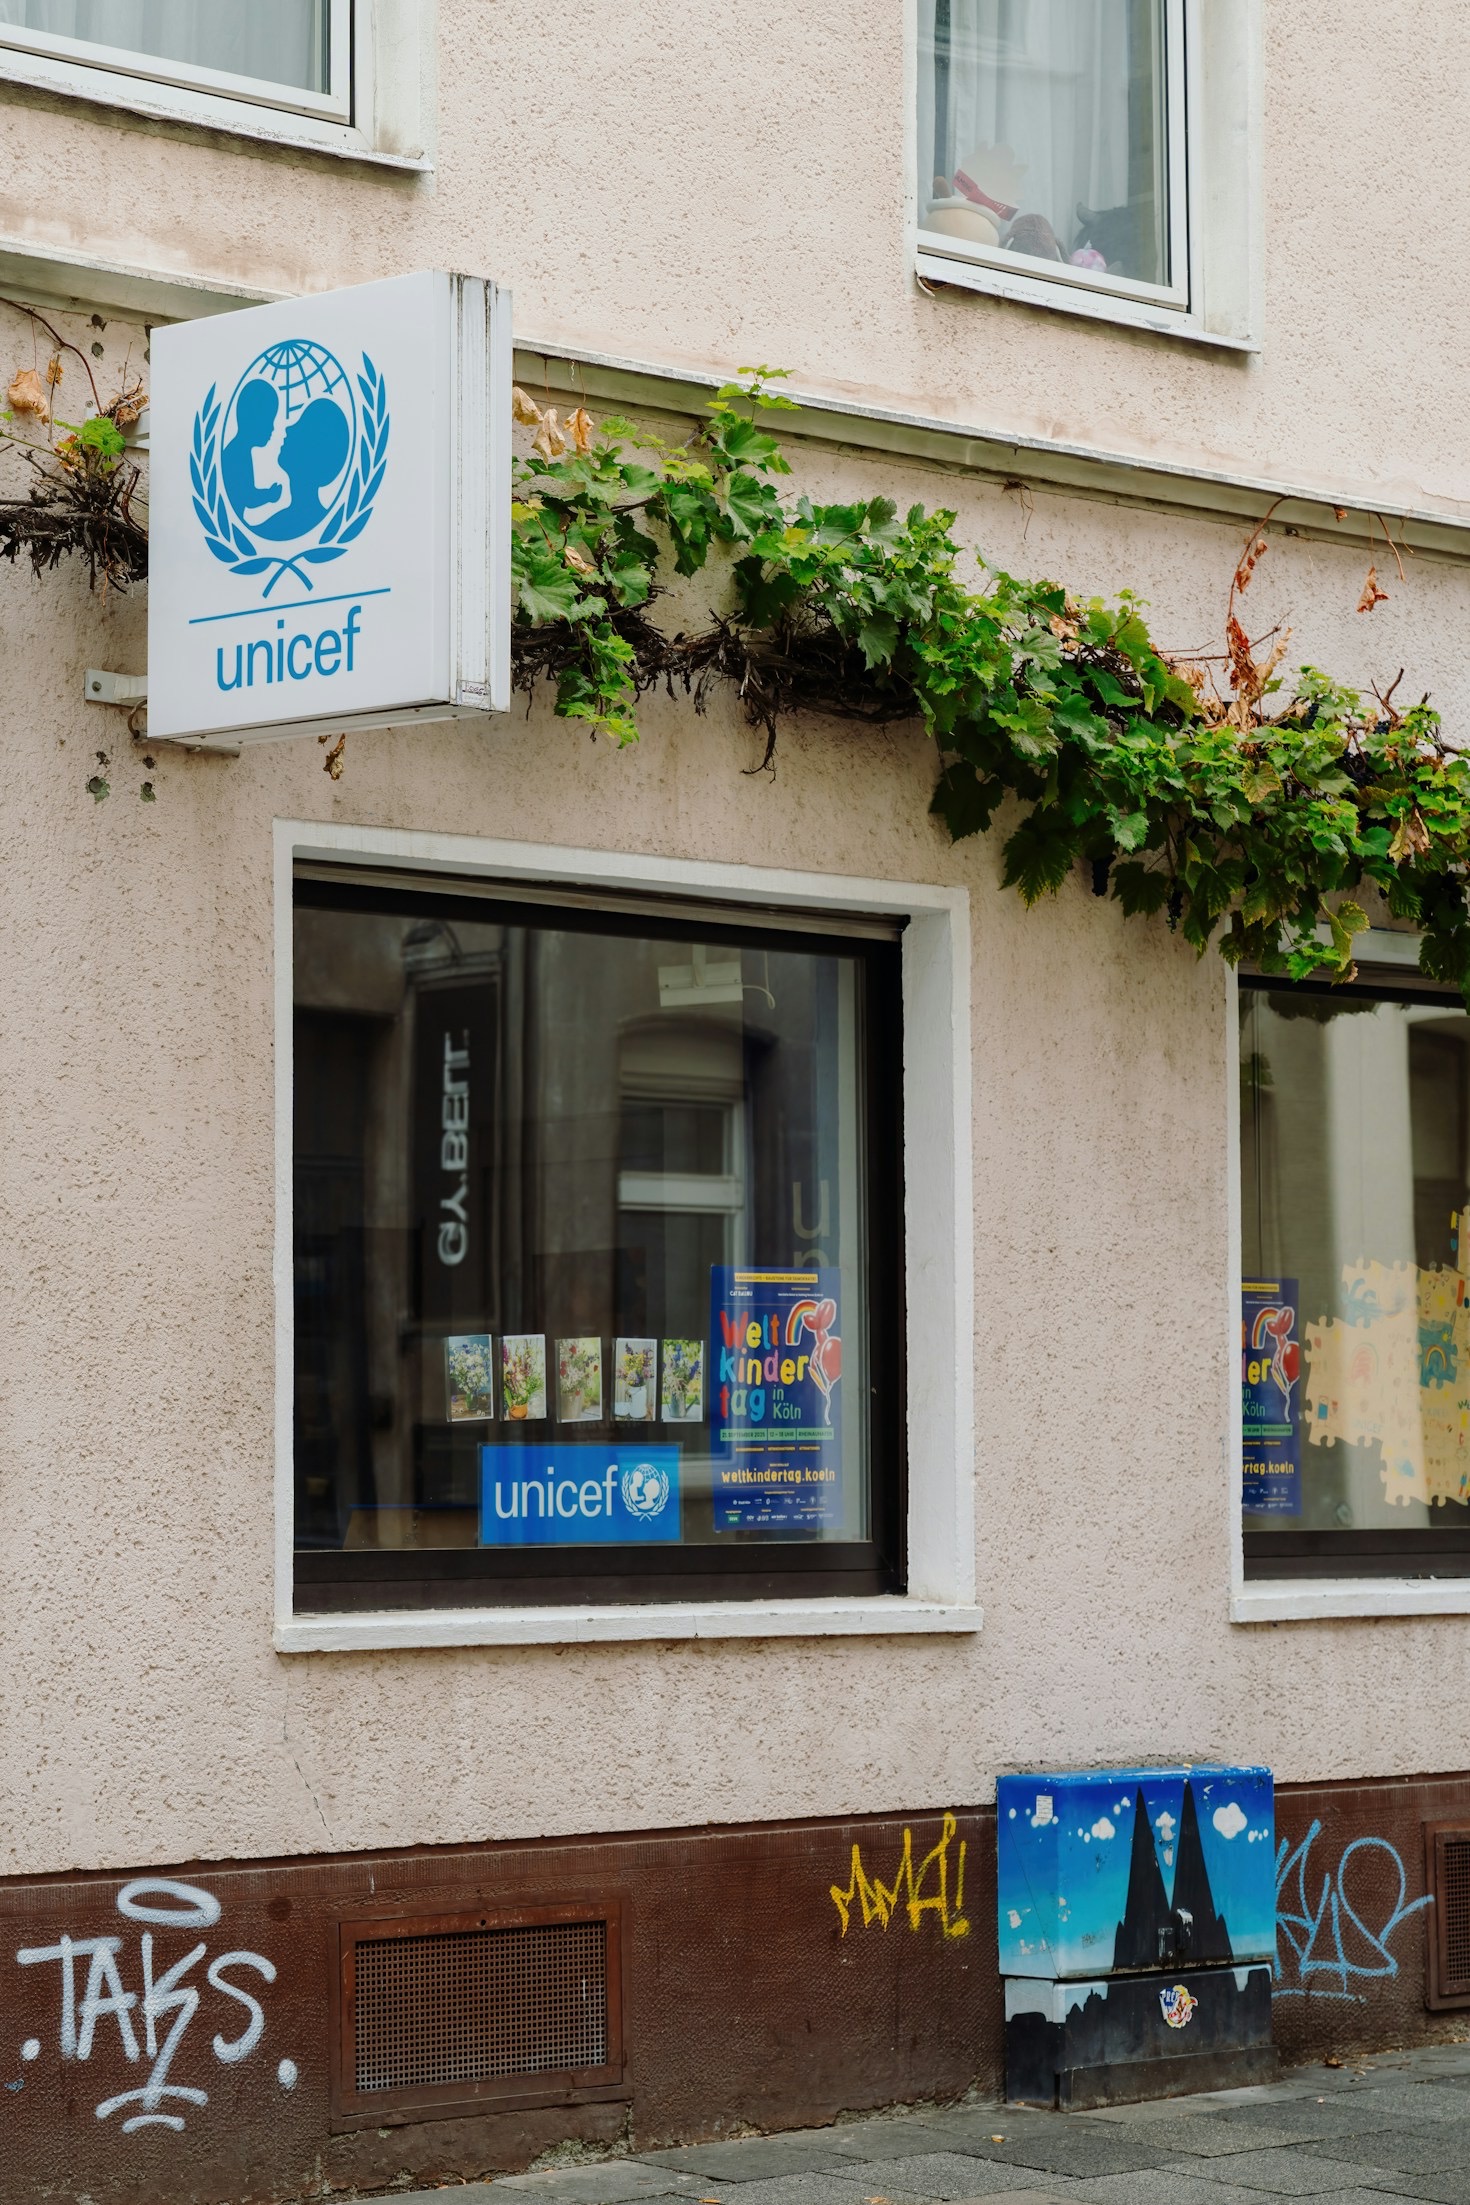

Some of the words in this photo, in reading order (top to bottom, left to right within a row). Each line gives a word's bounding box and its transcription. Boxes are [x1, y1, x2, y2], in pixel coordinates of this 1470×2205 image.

[216, 605, 361, 691] unicef
[720, 1311, 779, 1350] Welt
[720, 1347, 809, 1385] kinder
[720, 1386, 765, 1421] tag
[772, 1385, 785, 1400] in
[773, 1403, 802, 1420] Köln
[495, 1465, 619, 1519] unicef
[721, 1467, 836, 1484] weltkindertag.koeln
